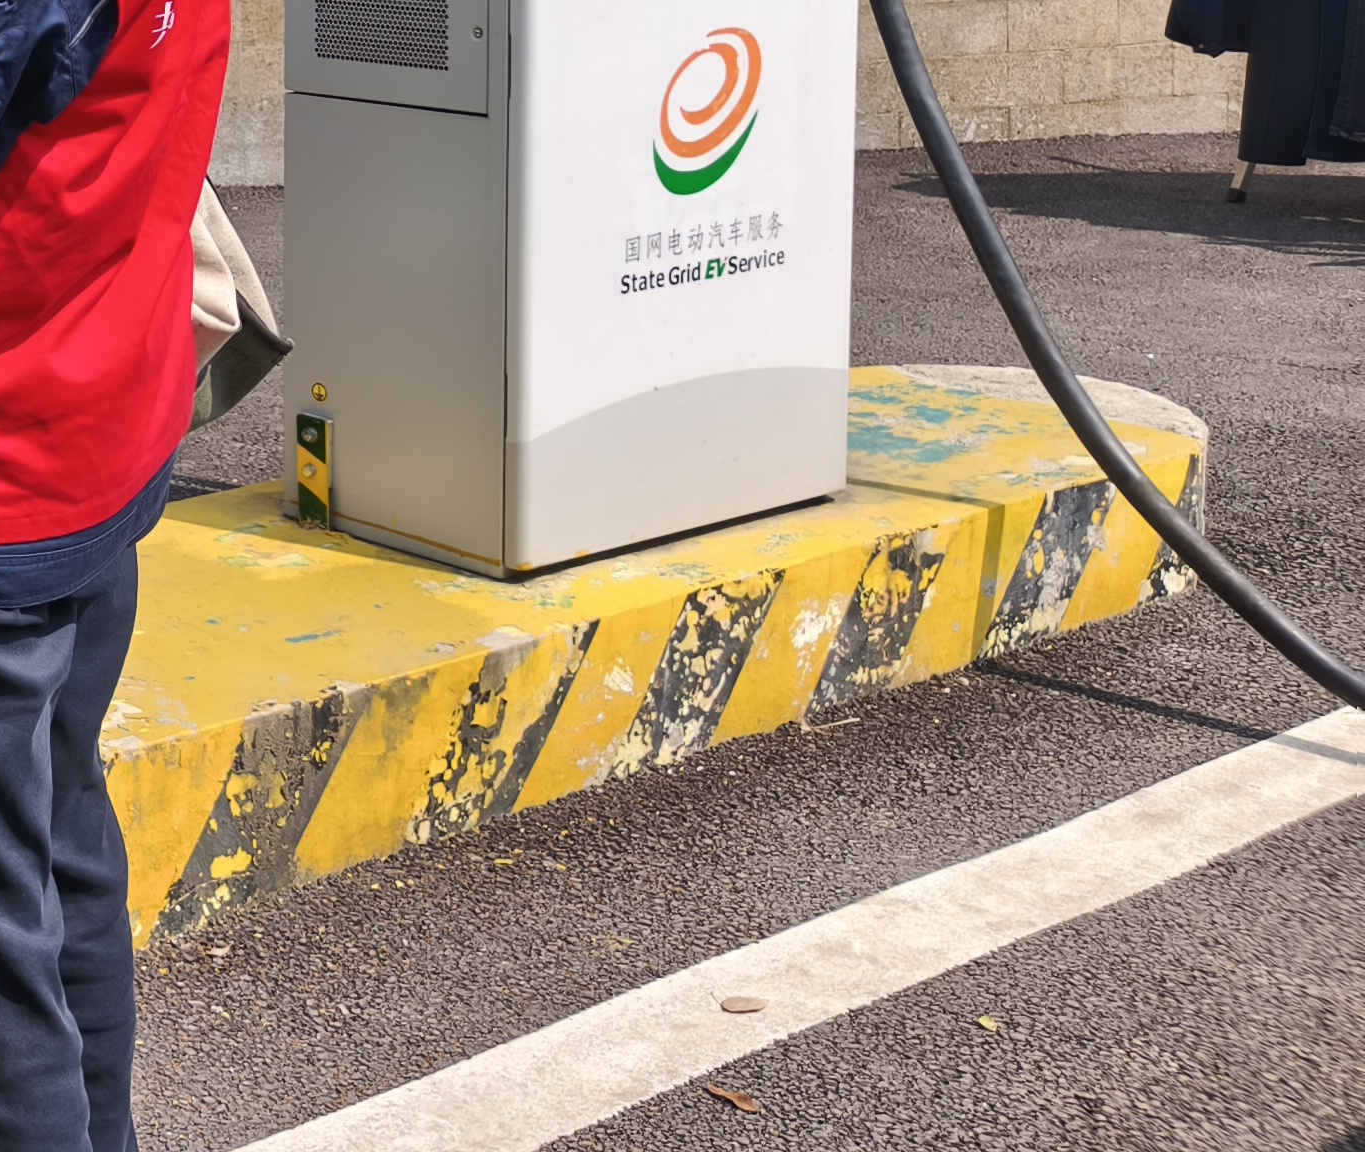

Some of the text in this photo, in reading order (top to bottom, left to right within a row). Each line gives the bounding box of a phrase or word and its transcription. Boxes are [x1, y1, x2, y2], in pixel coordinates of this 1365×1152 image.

[625, 210, 784, 263] 国网电动汽车服务
[621, 249, 785, 294] State Grid EV Service
